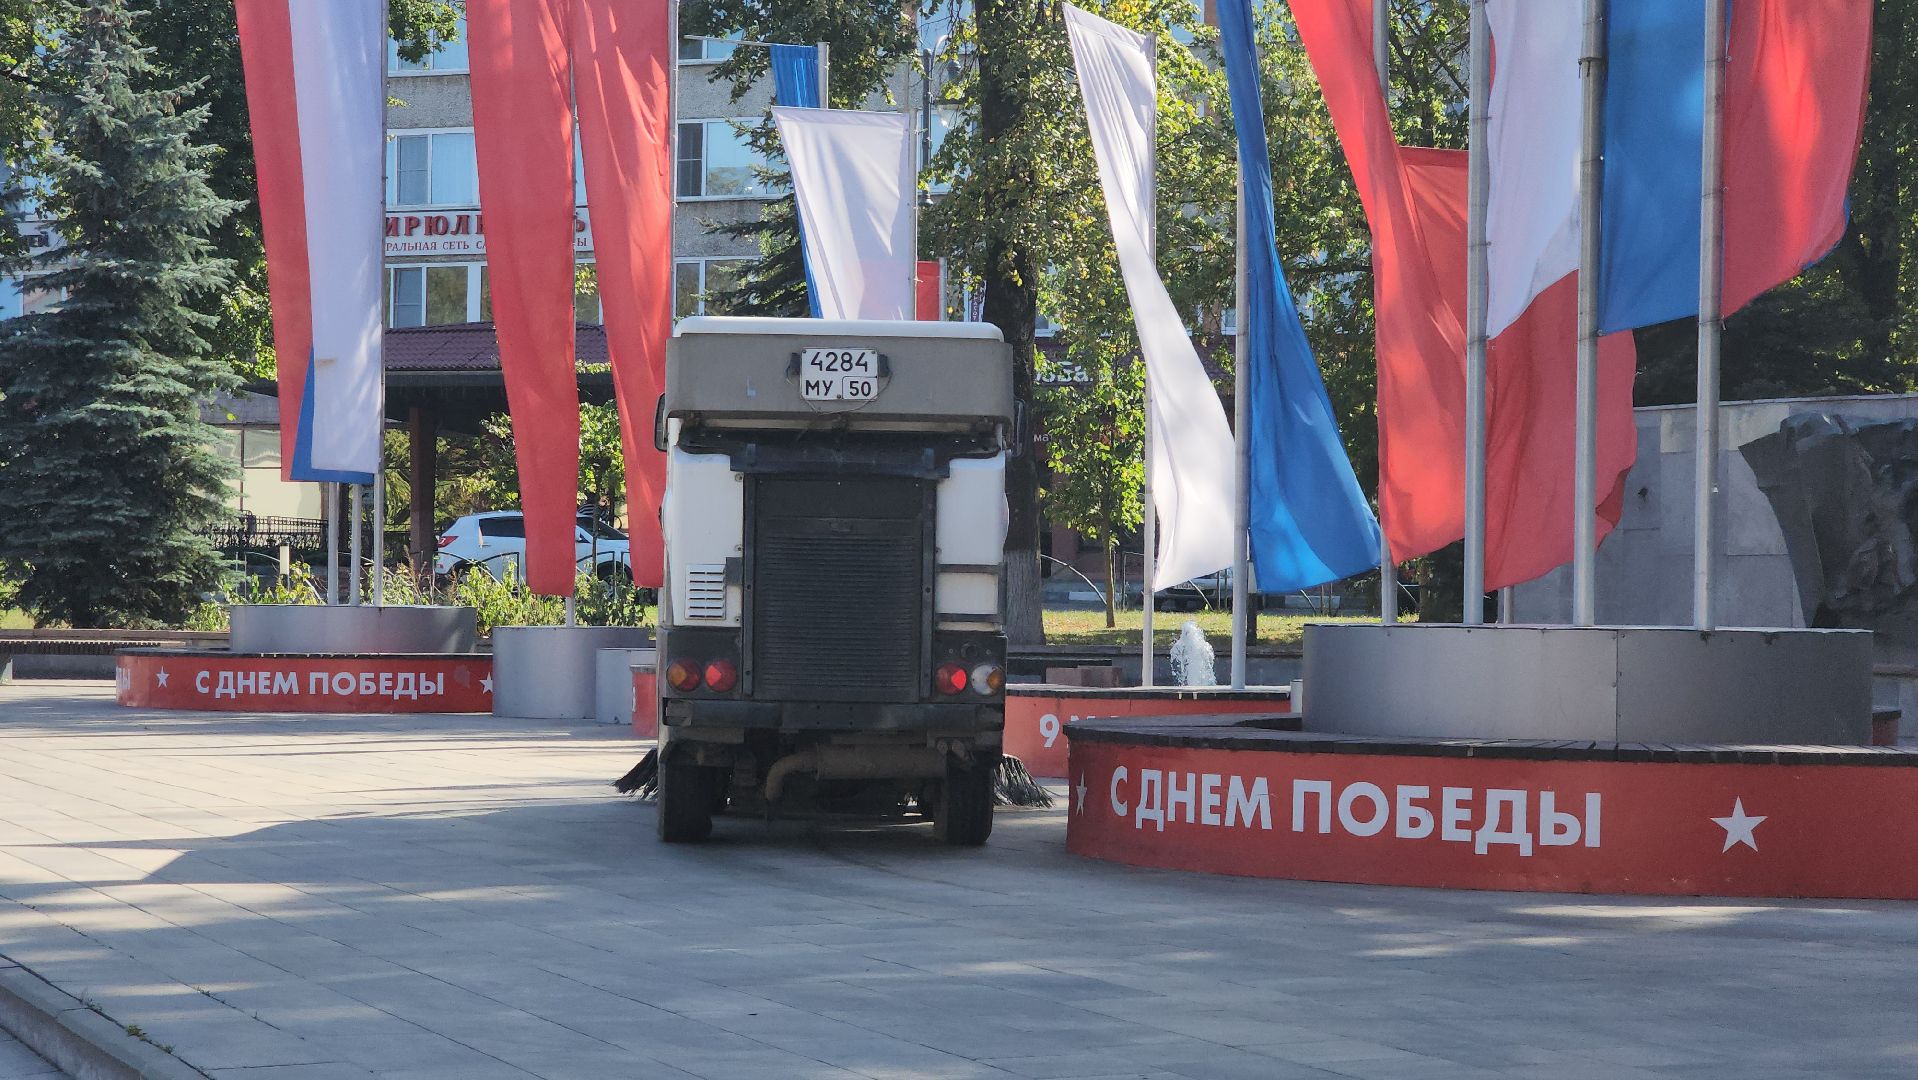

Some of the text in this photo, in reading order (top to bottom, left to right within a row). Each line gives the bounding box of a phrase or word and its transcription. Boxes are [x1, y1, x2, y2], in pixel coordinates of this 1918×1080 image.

[442, 240, 470, 250] СЕТЬ
[810, 351, 868, 372] 4284
[805, 379, 872, 397] МУ 50
[195, 671, 445, 700] С ДНЕМ ПОБЕДЫ
[1039, 713, 1060, 748] 9
[1110, 765, 1602, 857] С ДНЕМ ПОБЕДЫ
